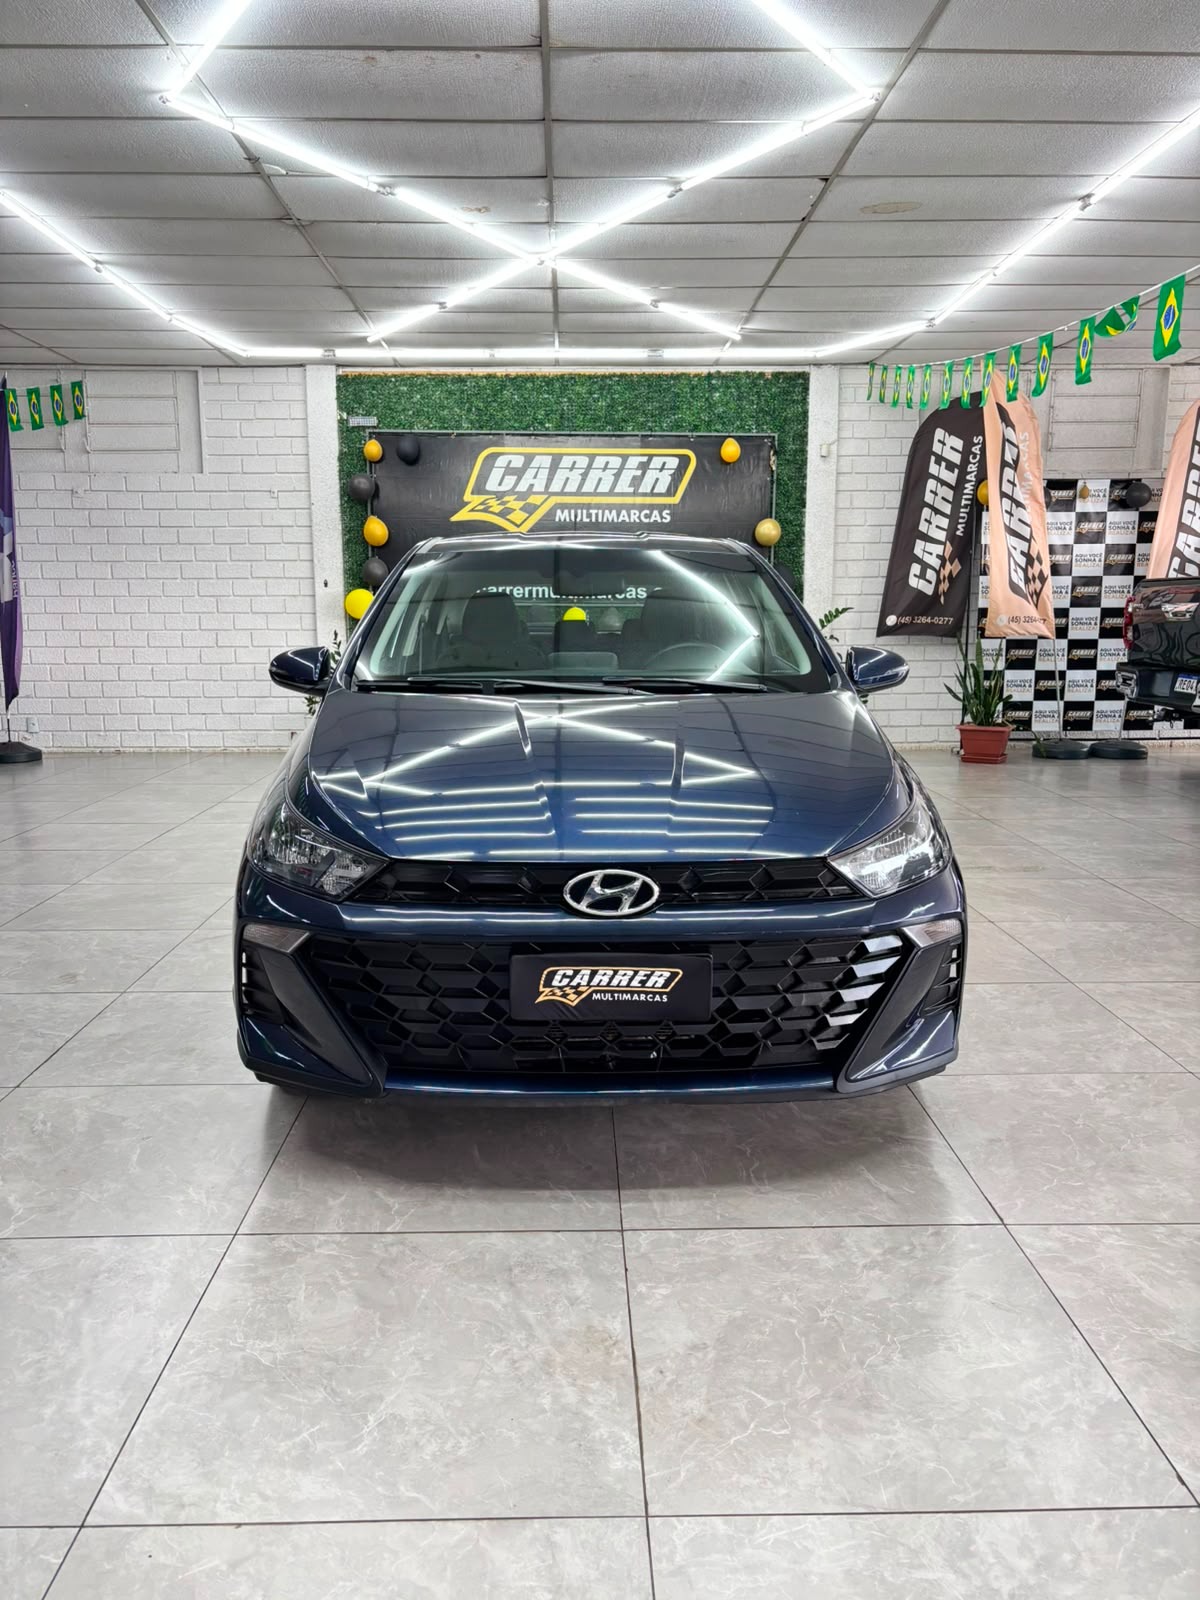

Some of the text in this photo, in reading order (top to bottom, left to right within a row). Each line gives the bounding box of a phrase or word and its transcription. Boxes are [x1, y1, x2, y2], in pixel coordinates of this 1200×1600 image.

[485, 454, 680, 494] CARRER
[956, 435, 983, 537] MULTIMARCAS
[555, 509, 672, 523] MULTIMARCAS
[908, 427, 963, 596] CARRER
[897, 615, 954, 625] (45) 3264-0277
[1008, 615, 1021, 625] (45)
[551, 969, 671, 988] CARRER
[592, 992, 668, 1002] MULTIMARCAS
